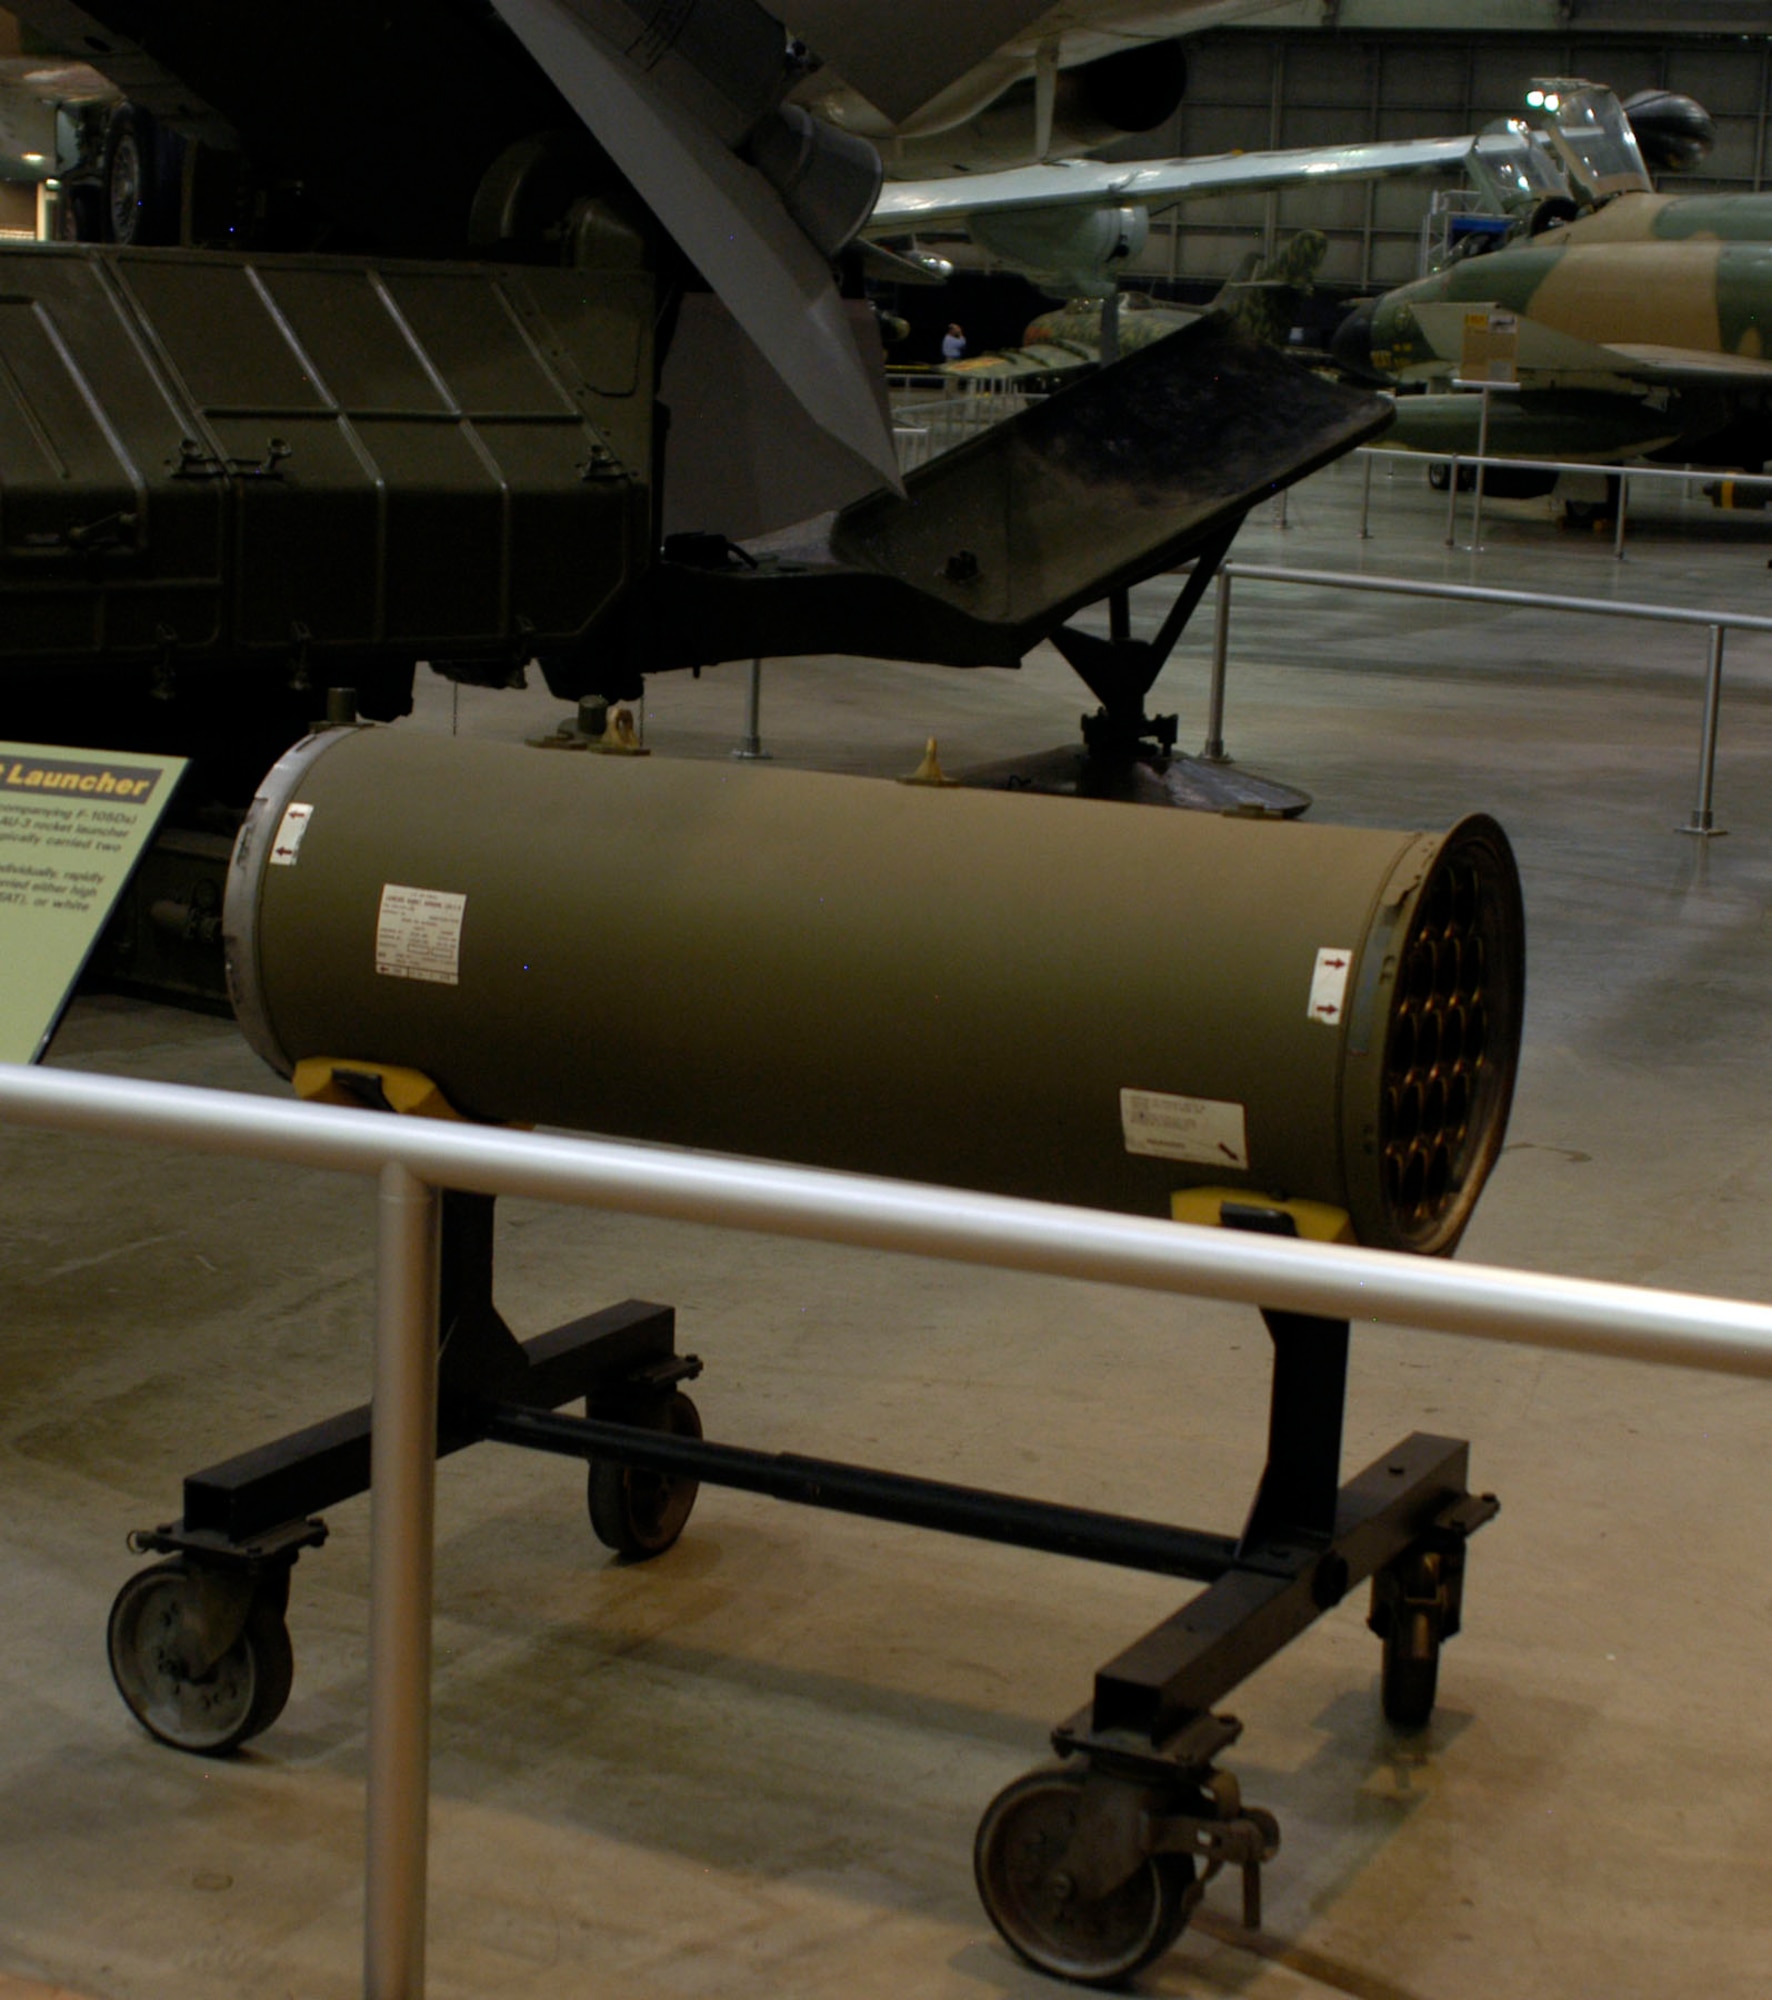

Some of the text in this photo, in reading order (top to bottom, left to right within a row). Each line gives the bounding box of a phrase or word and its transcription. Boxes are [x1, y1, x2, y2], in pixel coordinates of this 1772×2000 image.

[6, 763, 149, 796] Launcher
[33, 820, 73, 833] rocket
[75, 823, 129, 838] launcher
[45, 836, 92, 850] carried
[95, 841, 122, 852] two
[63, 871, 104, 884] rapidly
[32, 881, 68, 894] either
[70, 885, 97, 899] high
[33, 897, 47, 907] or
[53, 899, 90, 912] white
